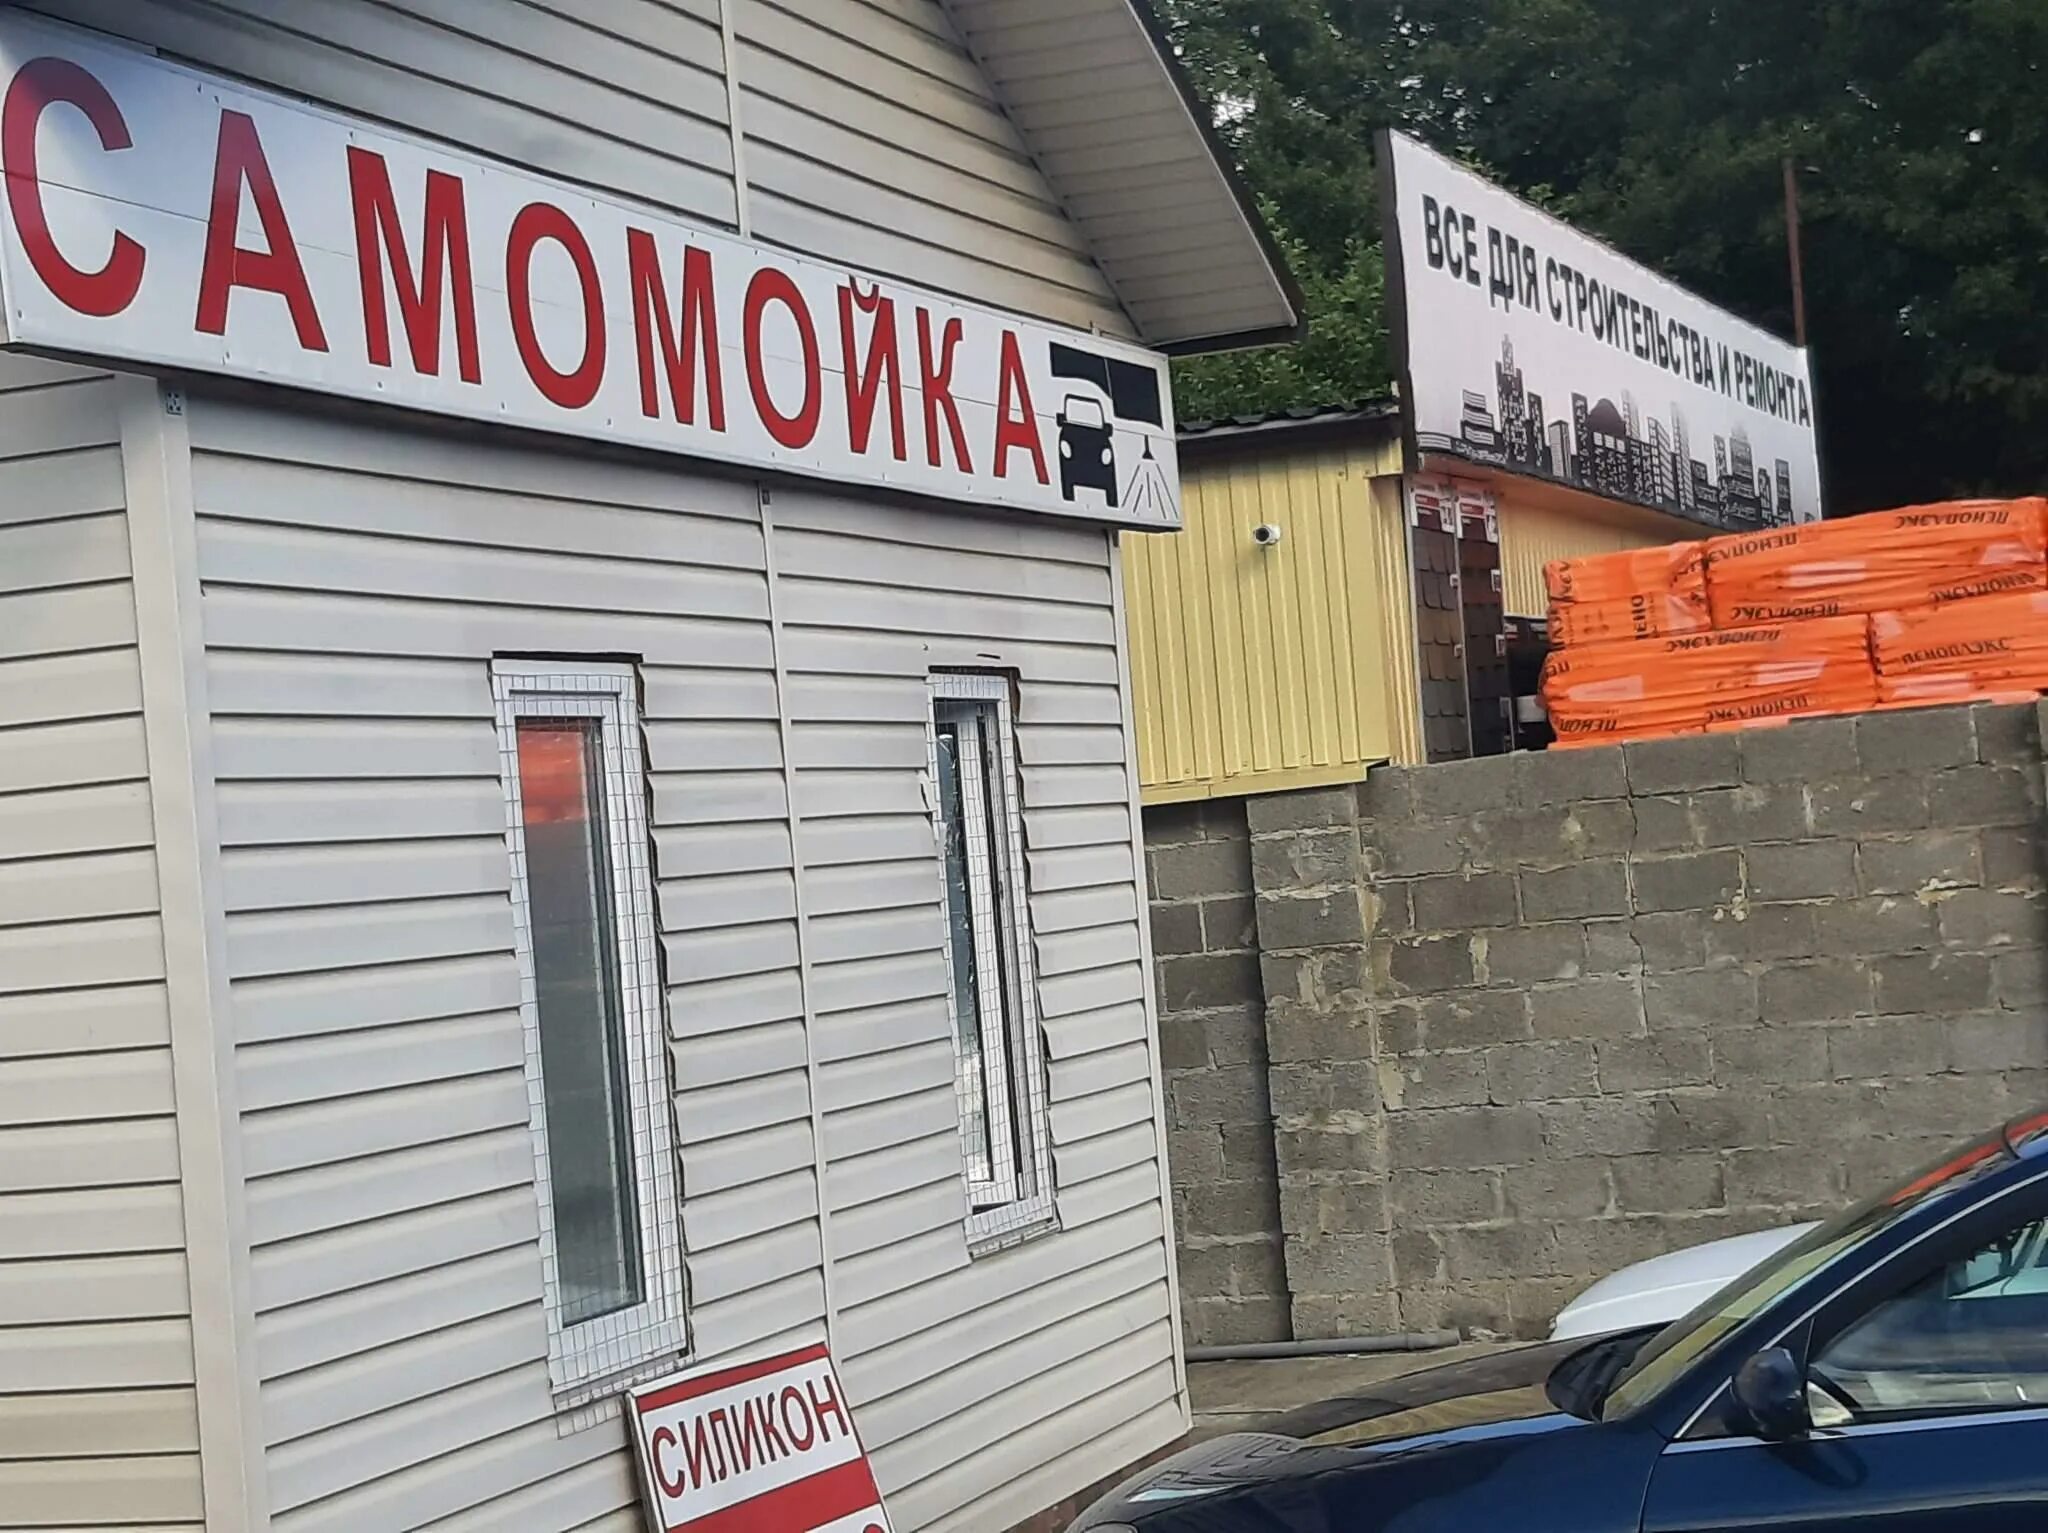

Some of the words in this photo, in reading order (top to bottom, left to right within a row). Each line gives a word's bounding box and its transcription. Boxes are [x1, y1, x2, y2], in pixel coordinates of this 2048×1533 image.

[1, 56, 1050, 486] САМОМОЙКА
[1421, 193, 1481, 287] ВСЕ
[1487, 225, 1541, 313] ДЛЯ
[1545, 256, 1717, 392] СТРОИТЕЛЬСТВА
[1717, 341, 1732, 398] И
[1733, 350, 1811, 428] РЕМОНТА
[1895, 511, 2009, 529] ПЕНОПЛЭКС
[652, 1375, 849, 1498] СИЛИКОН
